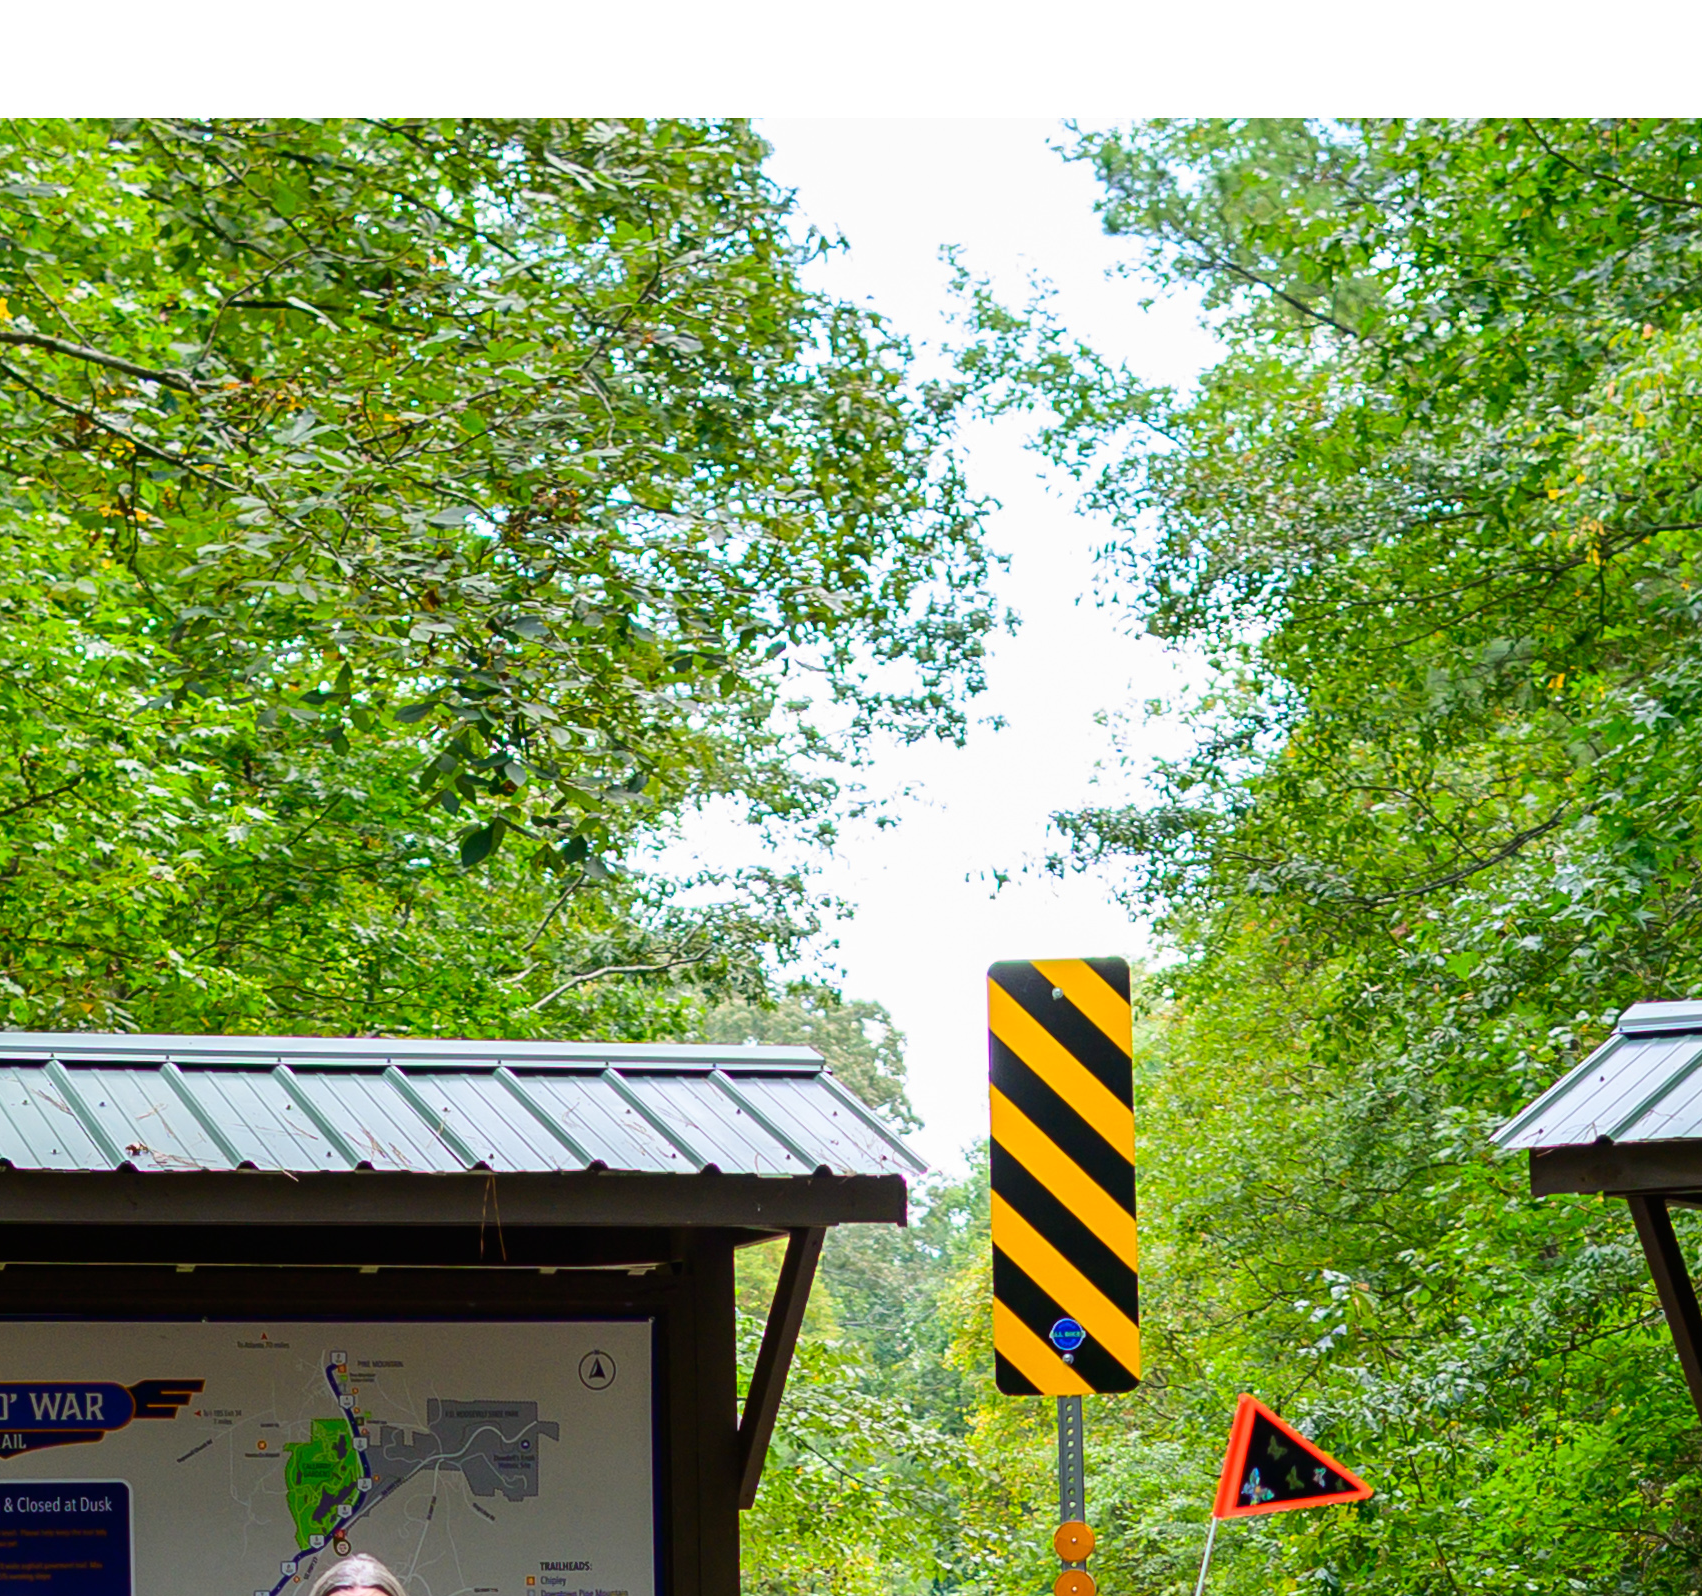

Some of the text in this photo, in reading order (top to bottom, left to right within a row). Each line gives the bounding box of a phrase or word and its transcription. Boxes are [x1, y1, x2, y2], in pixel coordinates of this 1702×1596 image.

[29, 1392, 104, 1421] WAR
[4, 1497, 13, 1512] &
[17, 1497, 60, 1512] Closed
[64, 1499, 77, 1511] at
[80, 1496, 112, 1511] Dusk
[540, 1561, 593, 1570] TRAILHEADS:
[540, 1576, 566, 1586] Chipley
[595, 1589, 628, 1596] Mountain
